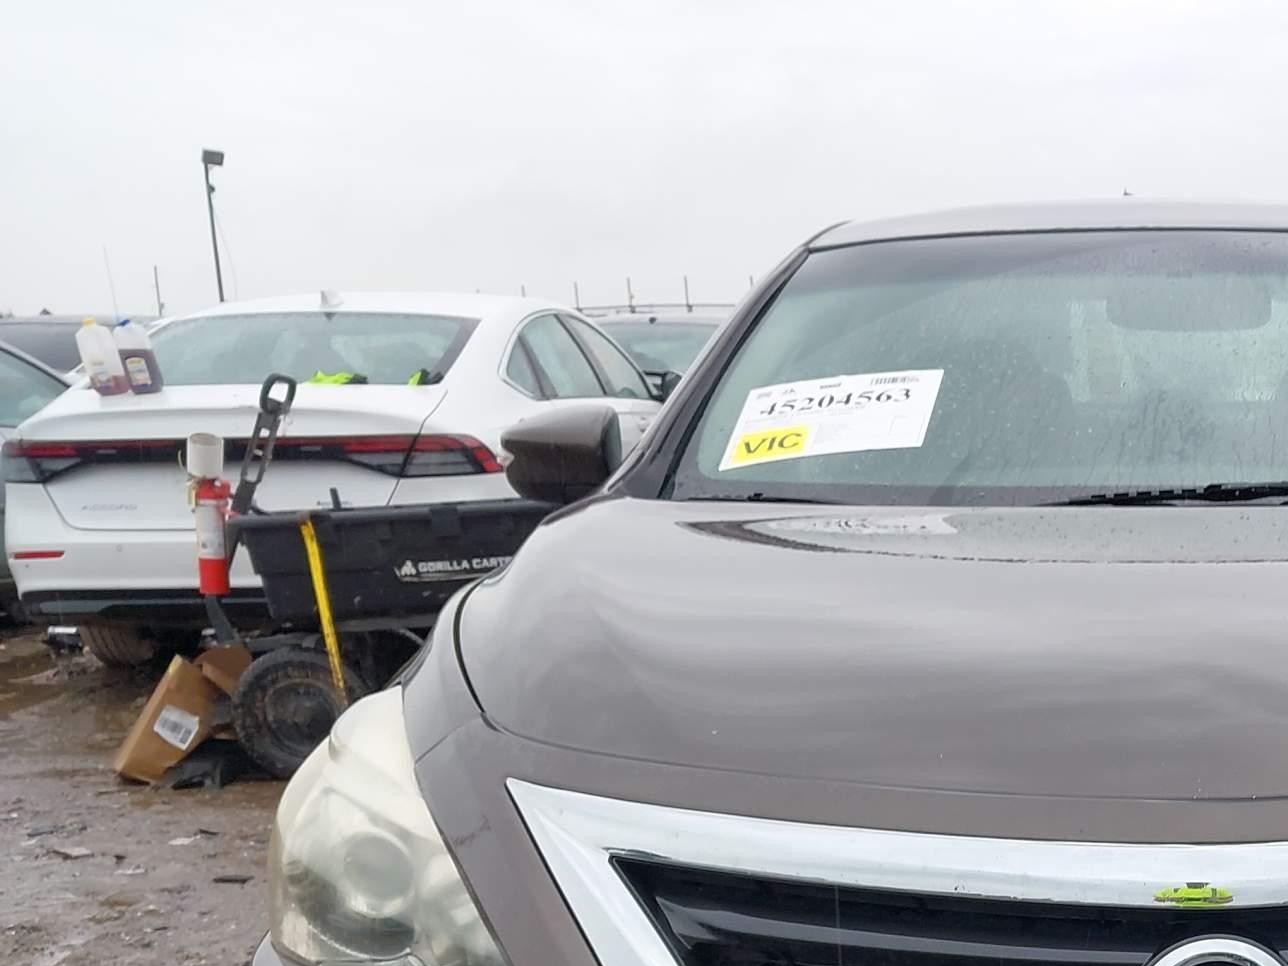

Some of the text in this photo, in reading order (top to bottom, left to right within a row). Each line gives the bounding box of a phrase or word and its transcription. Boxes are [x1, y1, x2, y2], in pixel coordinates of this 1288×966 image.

[759, 388, 911, 416] 45204563
[743, 432, 803, 454] VIC
[417, 560, 470, 572] GORILLA
